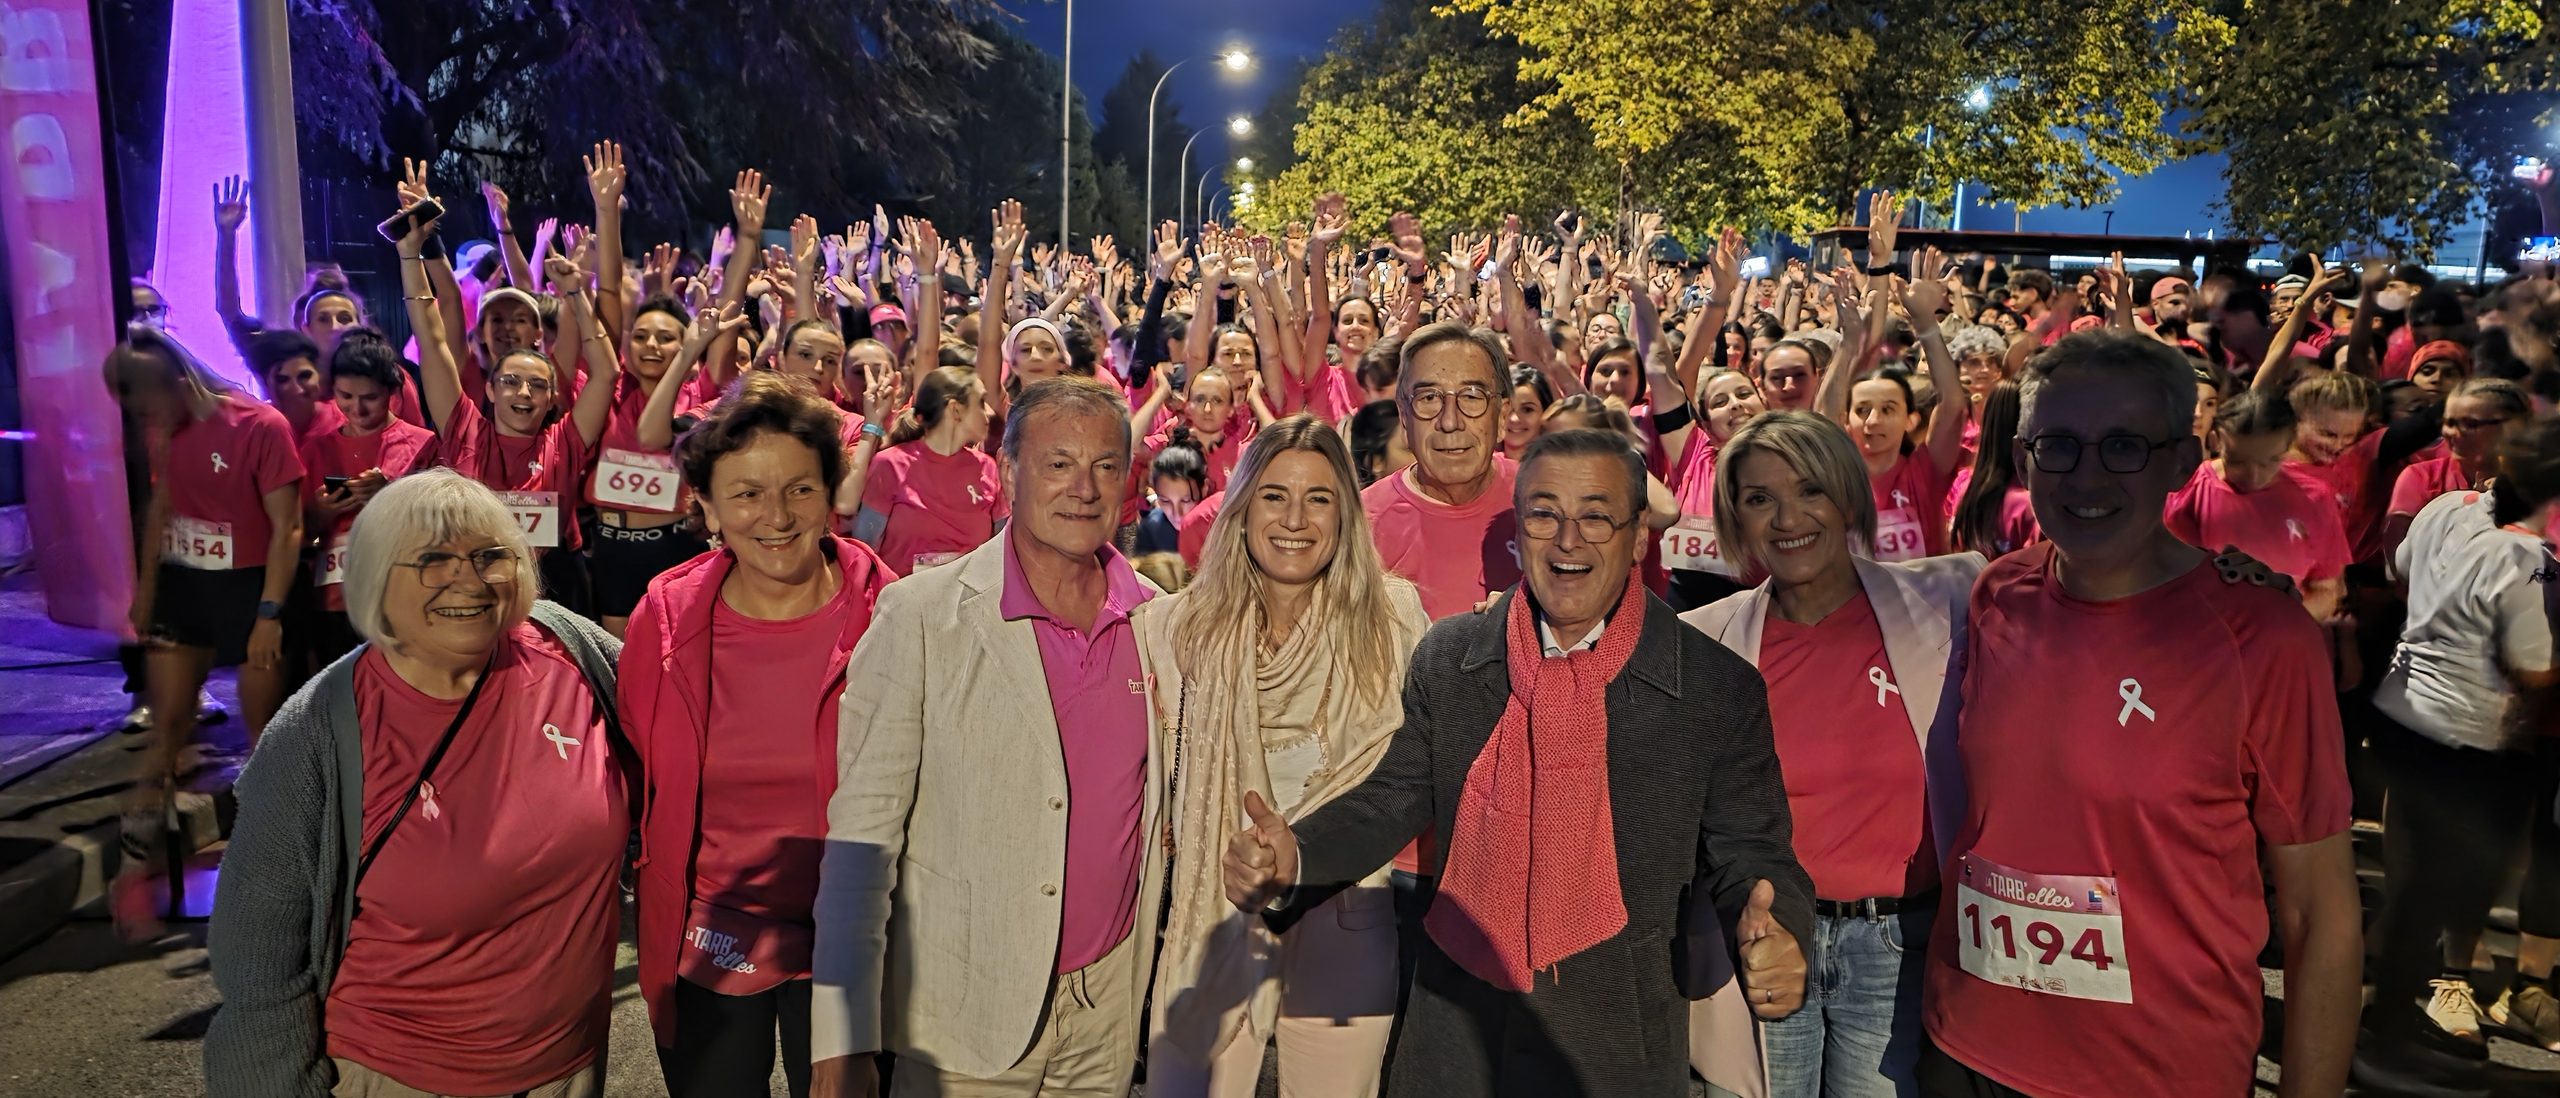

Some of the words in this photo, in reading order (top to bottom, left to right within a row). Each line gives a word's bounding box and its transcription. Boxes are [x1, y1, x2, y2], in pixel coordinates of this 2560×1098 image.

[608, 470, 662, 496] 696
[616, 528, 663, 542] PRO
[1963, 902, 2114, 971] 1194
[712, 951, 757, 974] elles
